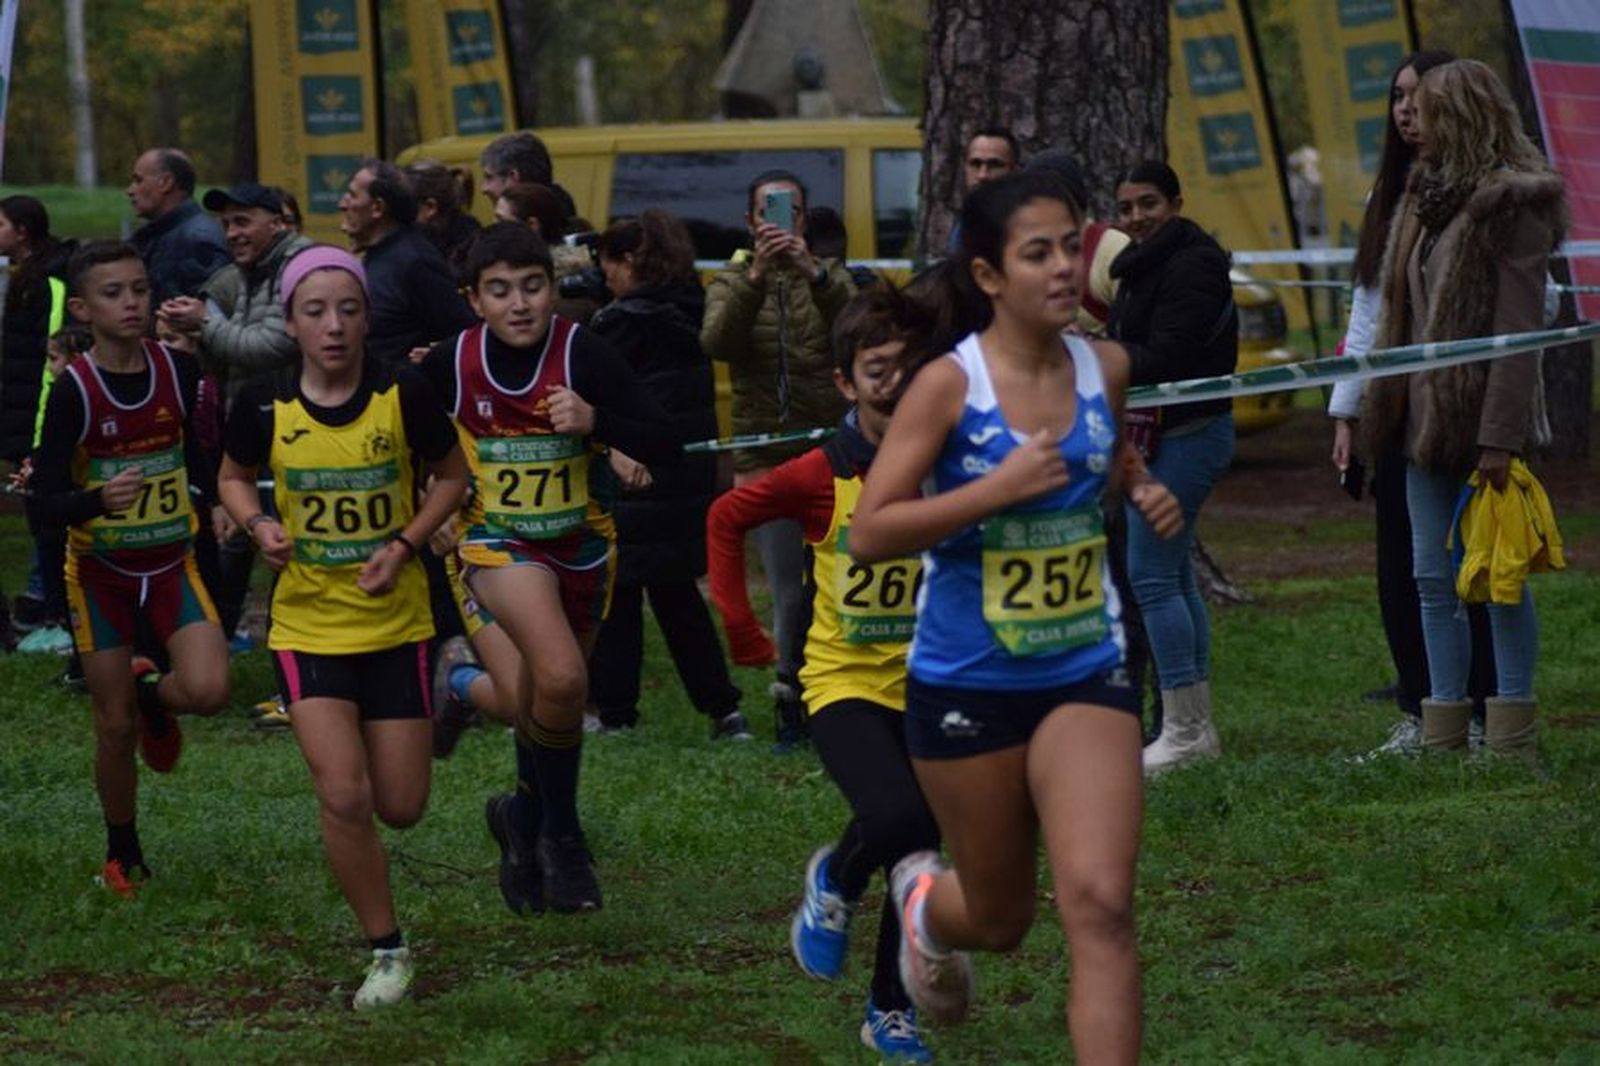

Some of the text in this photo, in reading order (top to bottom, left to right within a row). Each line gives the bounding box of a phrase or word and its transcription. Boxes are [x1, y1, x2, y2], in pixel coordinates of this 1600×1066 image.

[104, 478, 178, 520] 75
[497, 464, 571, 507] 271
[302, 492, 393, 534] 260
[1001, 547, 1093, 610] 252
